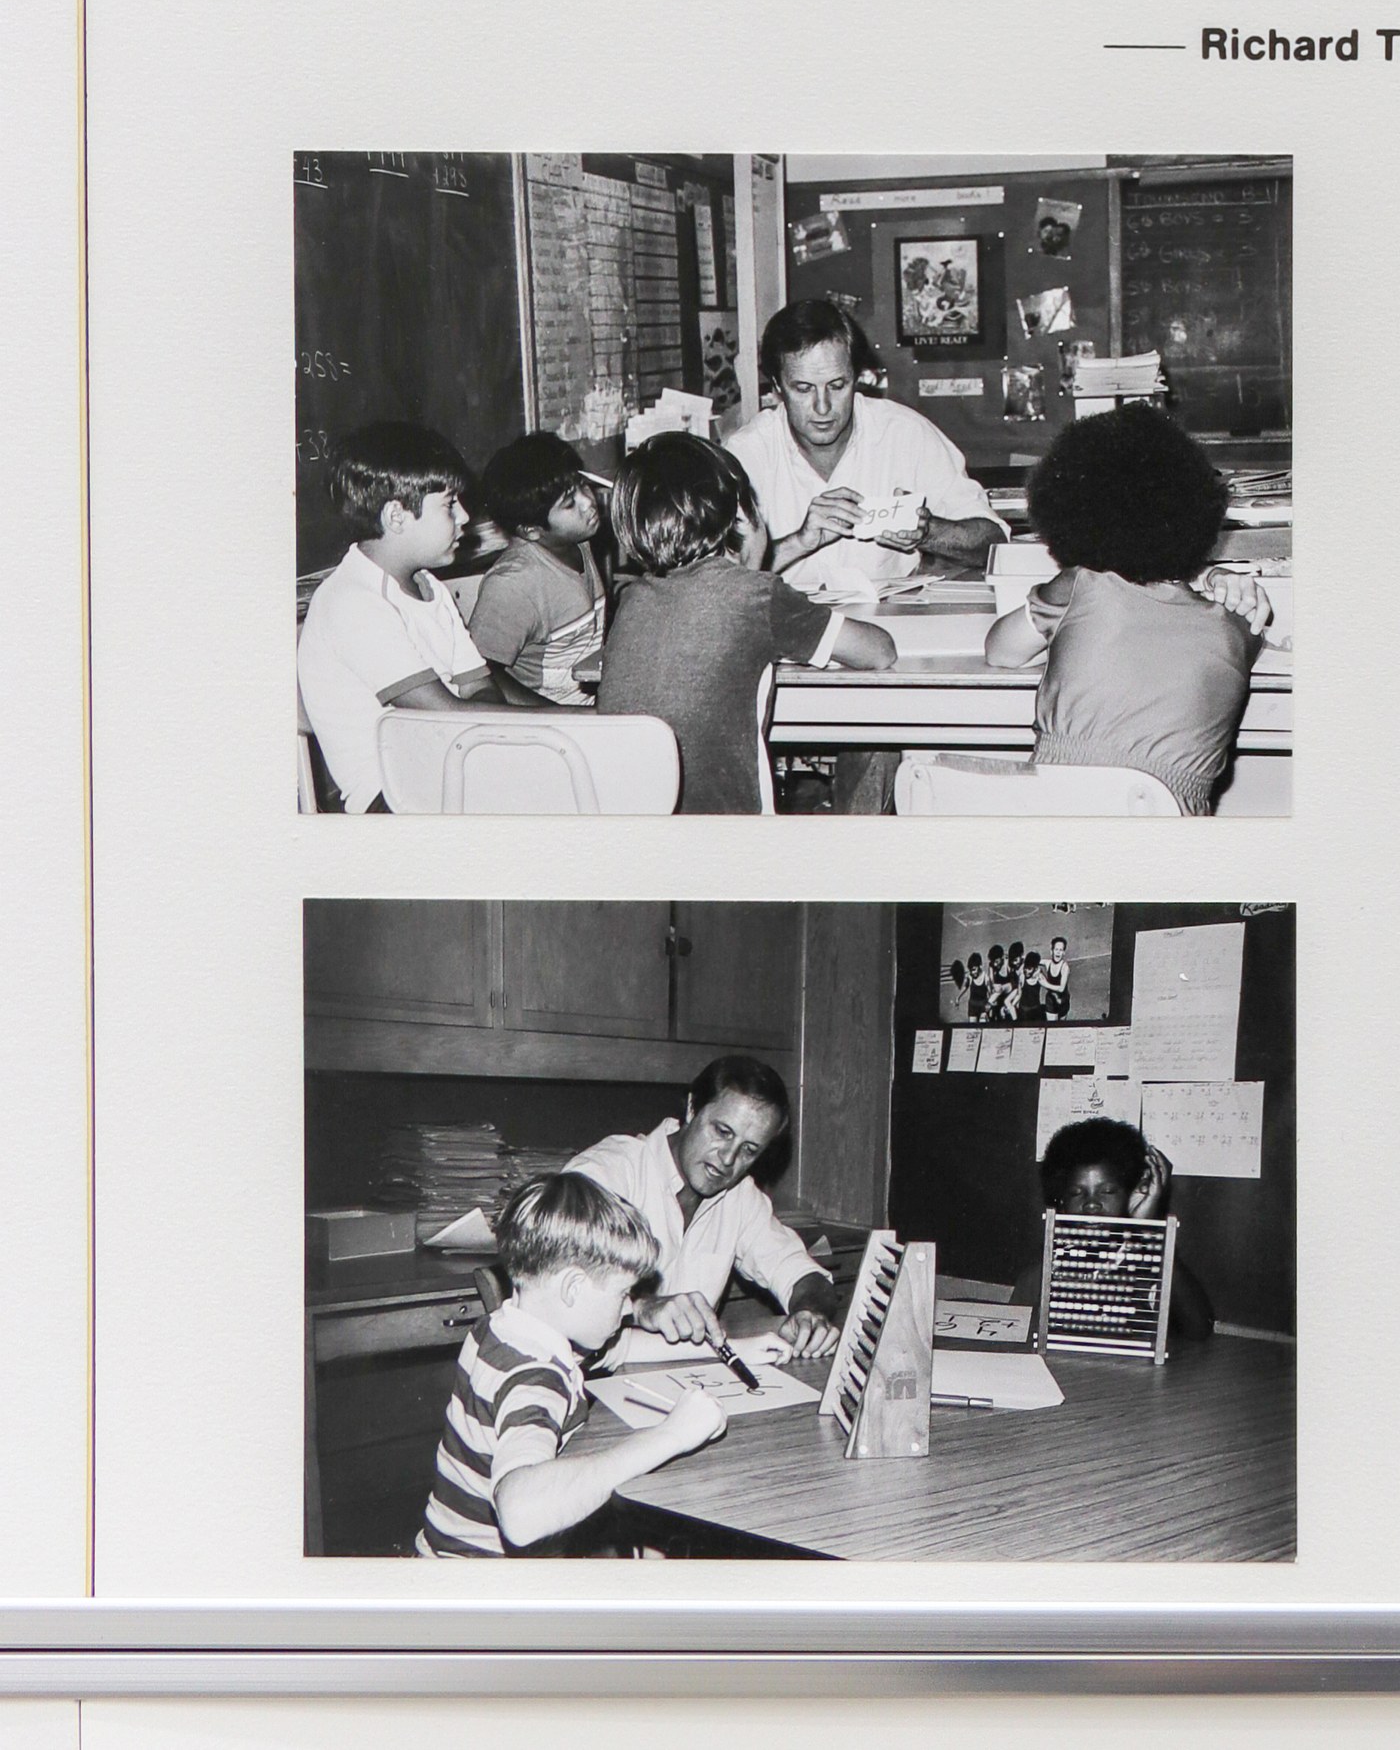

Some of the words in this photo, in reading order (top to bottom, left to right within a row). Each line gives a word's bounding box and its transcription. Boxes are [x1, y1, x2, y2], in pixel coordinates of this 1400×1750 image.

[1201, 27, 1359, 62] Richard
[1160, 212, 1204, 225] BOYS
[865, 500, 904, 525] got
